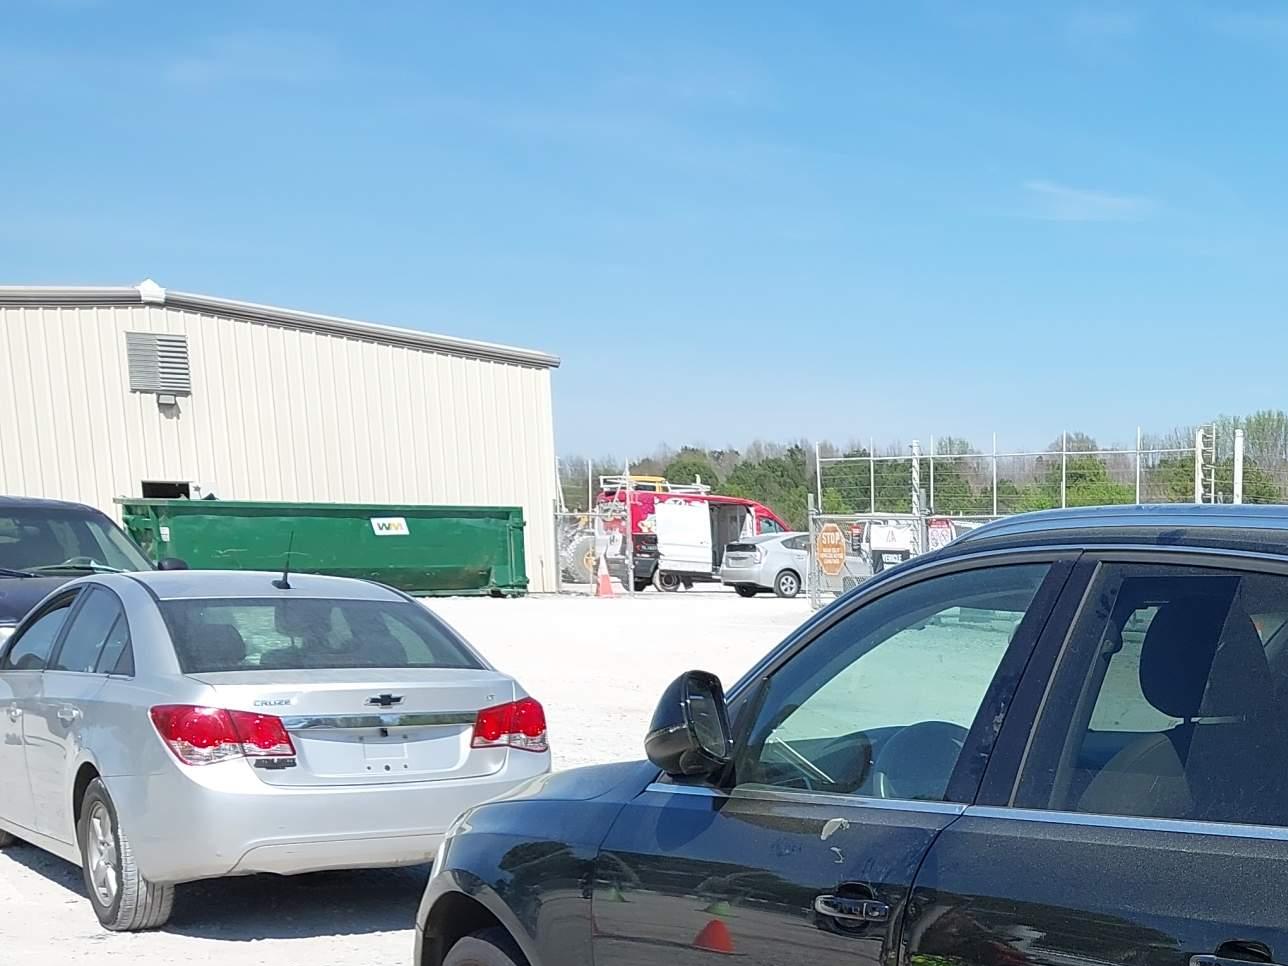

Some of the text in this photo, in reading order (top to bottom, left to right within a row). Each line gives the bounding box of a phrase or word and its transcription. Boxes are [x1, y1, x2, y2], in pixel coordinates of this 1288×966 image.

[377, 522, 404, 531] WM
[822, 532, 840, 545] STOP
[254, 699, 291, 707] CRUZE
